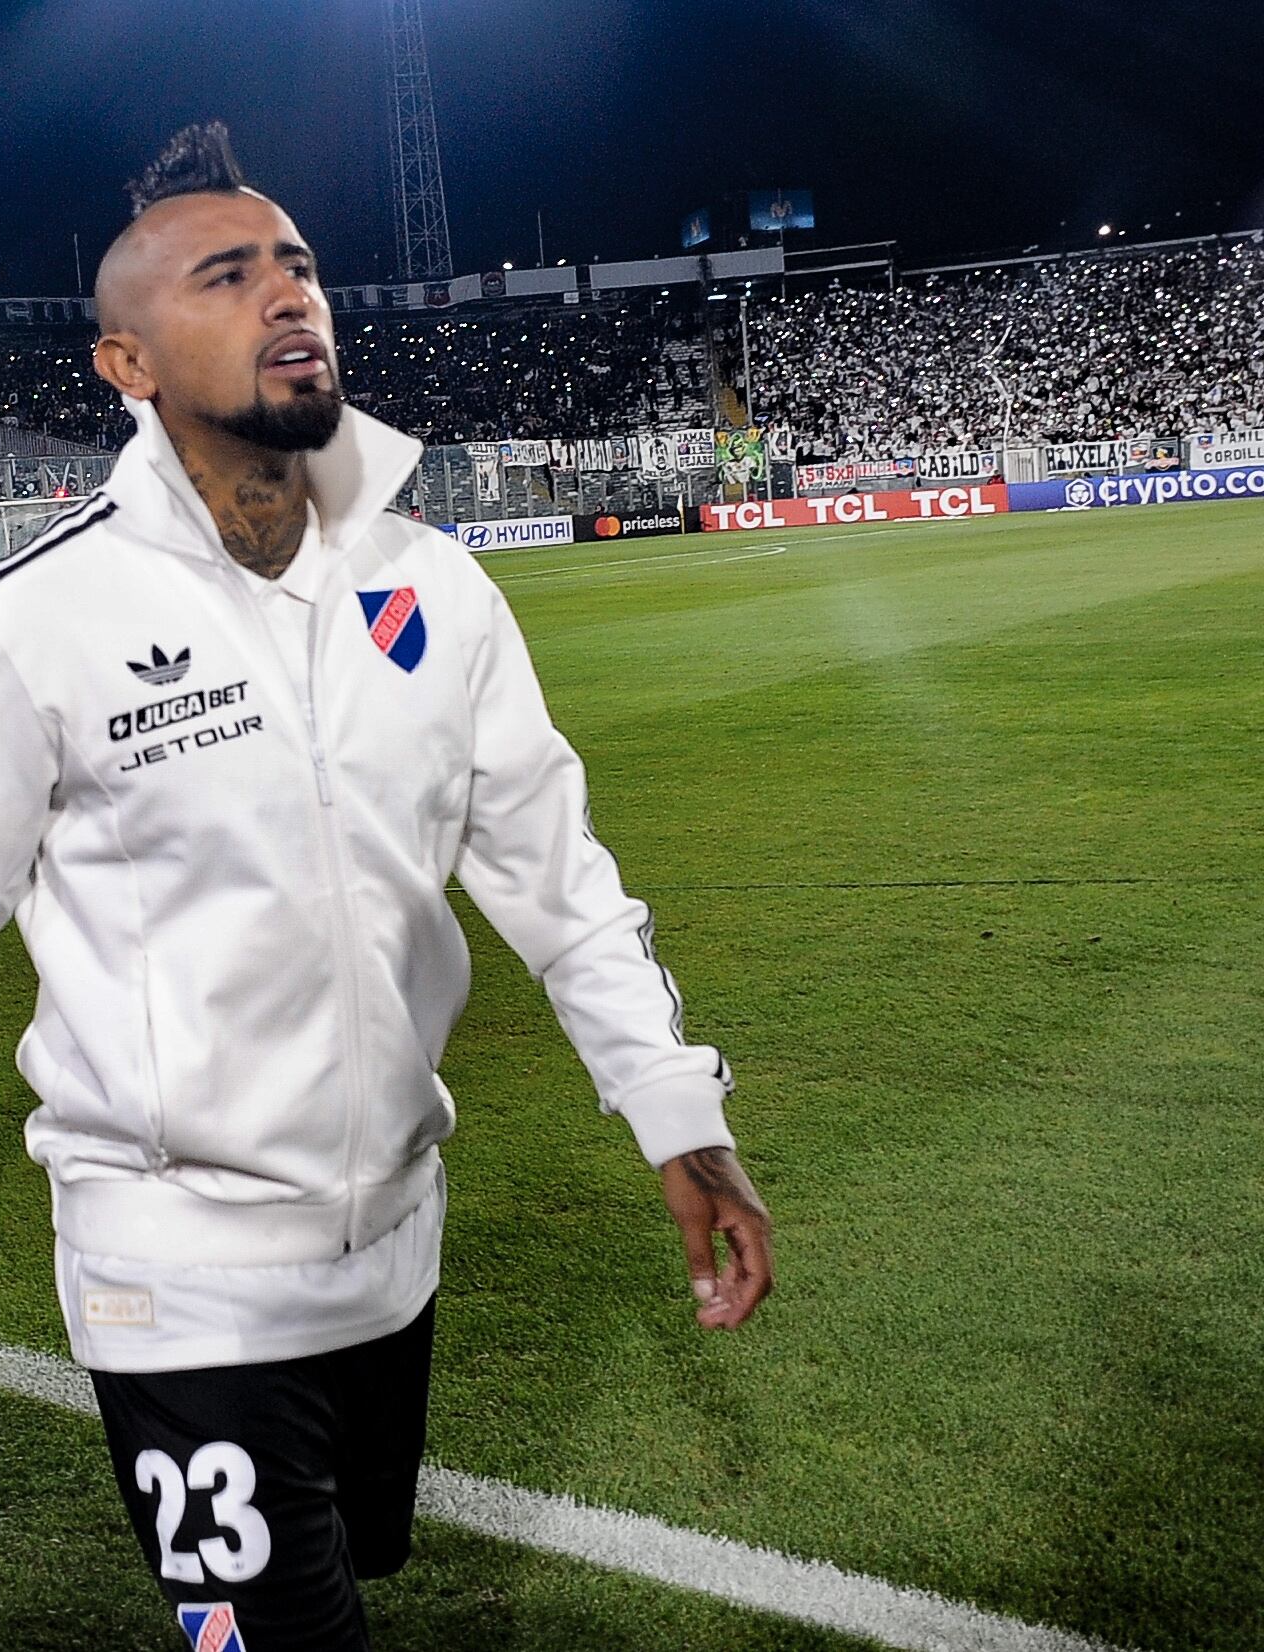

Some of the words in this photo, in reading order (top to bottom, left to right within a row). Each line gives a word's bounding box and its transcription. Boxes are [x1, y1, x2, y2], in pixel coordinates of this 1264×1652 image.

[1220, 430, 1264, 444] FAMIL
[1204, 447, 1264, 464] CORDILL
[1099, 470, 1264, 504] crypto.co
[711, 502, 785, 530] TCL
[807, 494, 888, 523] TCL
[910, 487, 995, 517] TCL
[497, 521, 570, 543] HYUNDAI
[622, 514, 681, 534] priceless
[120, 715, 263, 771] JETOUR
[136, 1441, 271, 1584] 23
